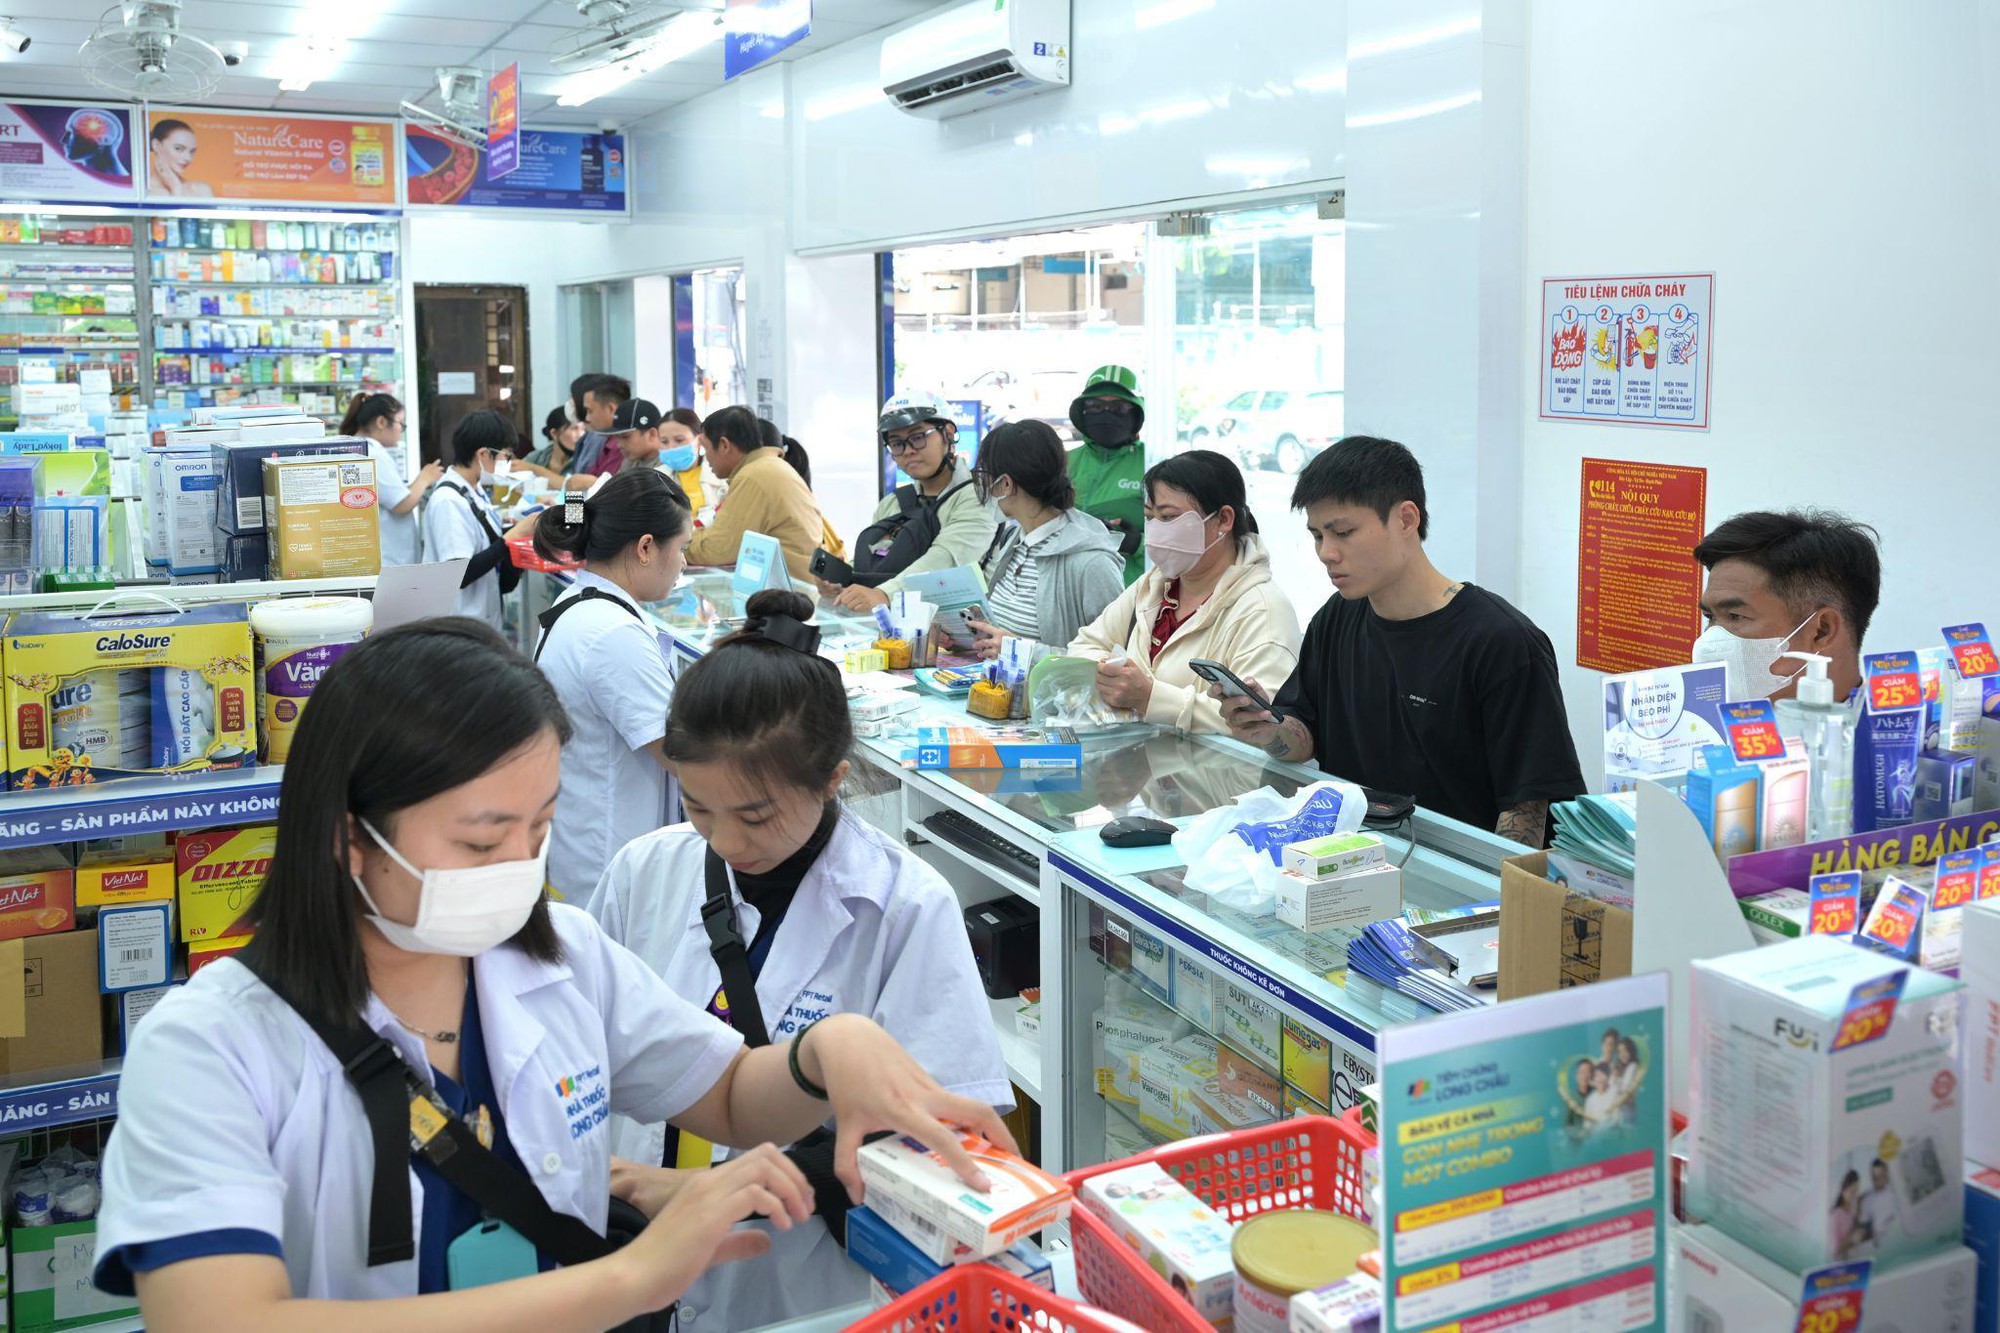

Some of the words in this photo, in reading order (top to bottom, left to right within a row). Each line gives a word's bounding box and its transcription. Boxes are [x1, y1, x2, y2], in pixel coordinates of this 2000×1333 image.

[1036, 43, 1044, 54] 2
[234, 130, 323, 149] NatureCare
[520, 141, 567, 155] ureCare
[1565, 285, 1587, 299] TIÊU
[1590, 283, 1618, 300] LỆNH
[1621, 281, 1651, 298] CHỮA
[1655, 281, 1687, 297] CHÁY
[1567, 309, 1572, 320] 1
[1600, 309, 1608, 321] 2
[1637, 308, 1644, 320] 3
[1674, 308, 1683, 320] 4
[1554, 350, 1582, 366] ĐỘNG
[175, 463, 207, 471] OMRON
[1118, 478, 1141, 490] Gra
[1601, 481, 1615, 492] 114
[1621, 489, 1638, 502] NỘI
[1640, 493, 1660, 503] QUY
[96, 633, 171, 652] CaloSure
[1960, 653, 1995, 676] 20%
[51, 683, 92, 709] ure
[182, 693, 191, 713] CAO
[1875, 685, 1917, 707] 25%
[1876, 715, 1914, 729] ハトムギ
[86, 736, 106, 745] HMB
[1736, 733, 1778, 757] 35%
[1875, 754, 1886, 809] HATOMUGI
[0, 819, 40, 838] ĂNG
[61, 812, 104, 832] SẢN
[110, 805, 169, 827] PHẨM
[174, 801, 215, 819] NÀY
[1810, 839, 1901, 876] HÀNG
[1908, 822, 1970, 865] BÁN
[191, 857, 273, 882] DIZZO
[104, 873, 144, 887] VietNat
[1981, 879, 2000, 898] 20
[1937, 884, 1971, 907] 20%
[1814, 911, 1853, 934] 20%
[1871, 914, 1907, 938] 20%
[1210, 948, 1232, 966] THUỐC
[1233, 961, 1258, 981] KHÔNG
[1258, 974, 1269, 987] KÊ
[1269, 983, 1285, 999] ĐƠN
[802, 990, 814, 999] FPT
[814, 992, 833, 1002] Retail
[1228, 986, 1250, 1009] SUT
[1142, 1080, 1170, 1103] Varogel
[1436, 1082, 1473, 1102] LONG
[0, 1103, 48, 1123] ĂNG
[69, 1091, 110, 1111] SẢN
[571, 1115, 593, 1140] ONG
[1801, 1305, 1857, 1333] 20%
